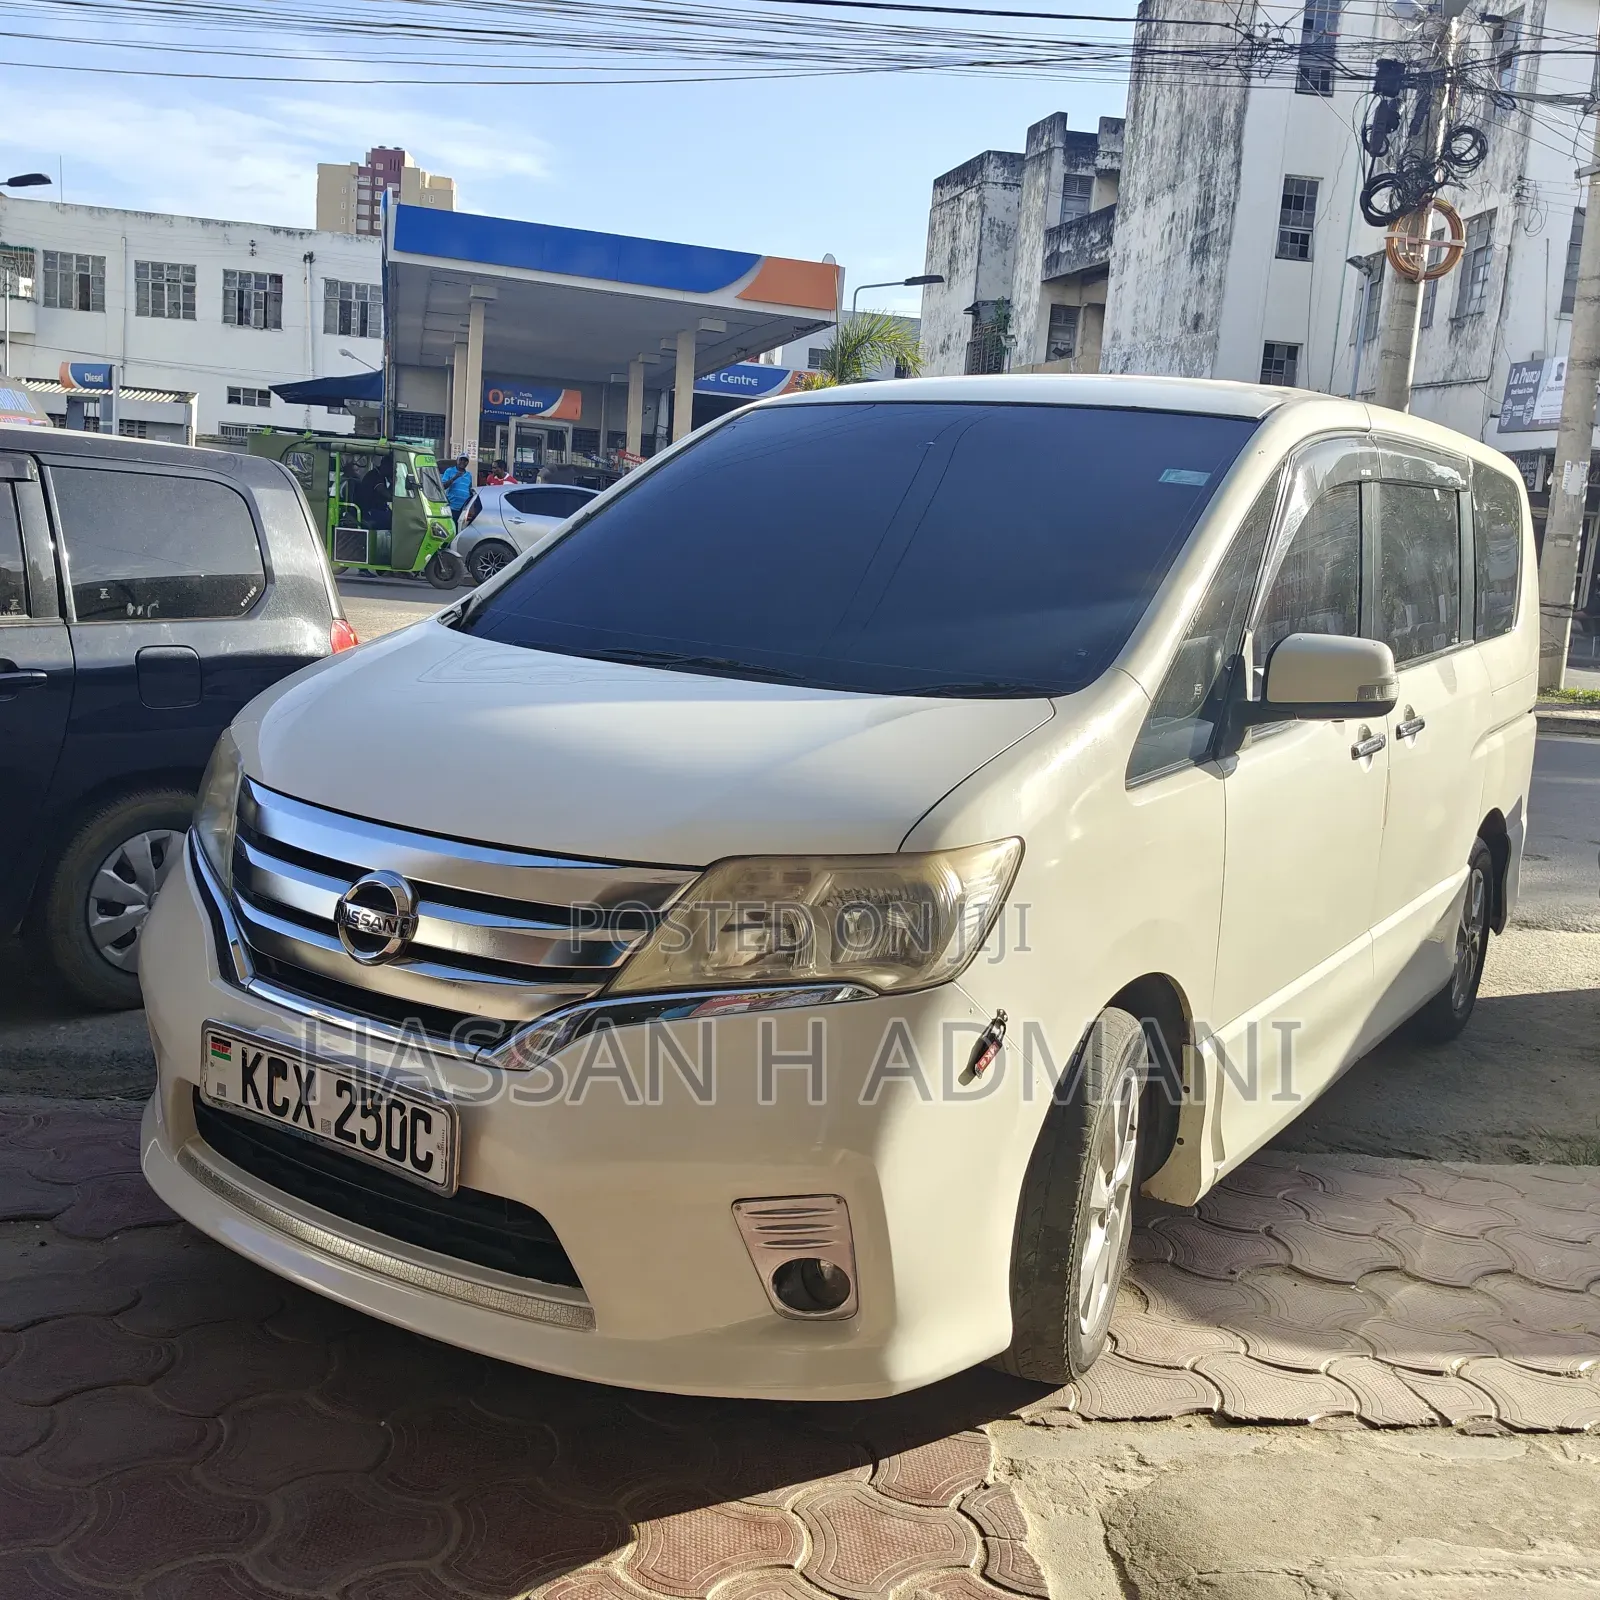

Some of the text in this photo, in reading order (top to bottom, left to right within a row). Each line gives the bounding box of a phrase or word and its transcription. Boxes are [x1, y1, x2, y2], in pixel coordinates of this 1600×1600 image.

[84, 372, 104, 383] Diesel
[720, 373, 758, 386] Centre
[337, 902, 397, 934] NISSAN
[241, 1046, 316, 1130] KCX
[334, 1079, 434, 1174] 250C
